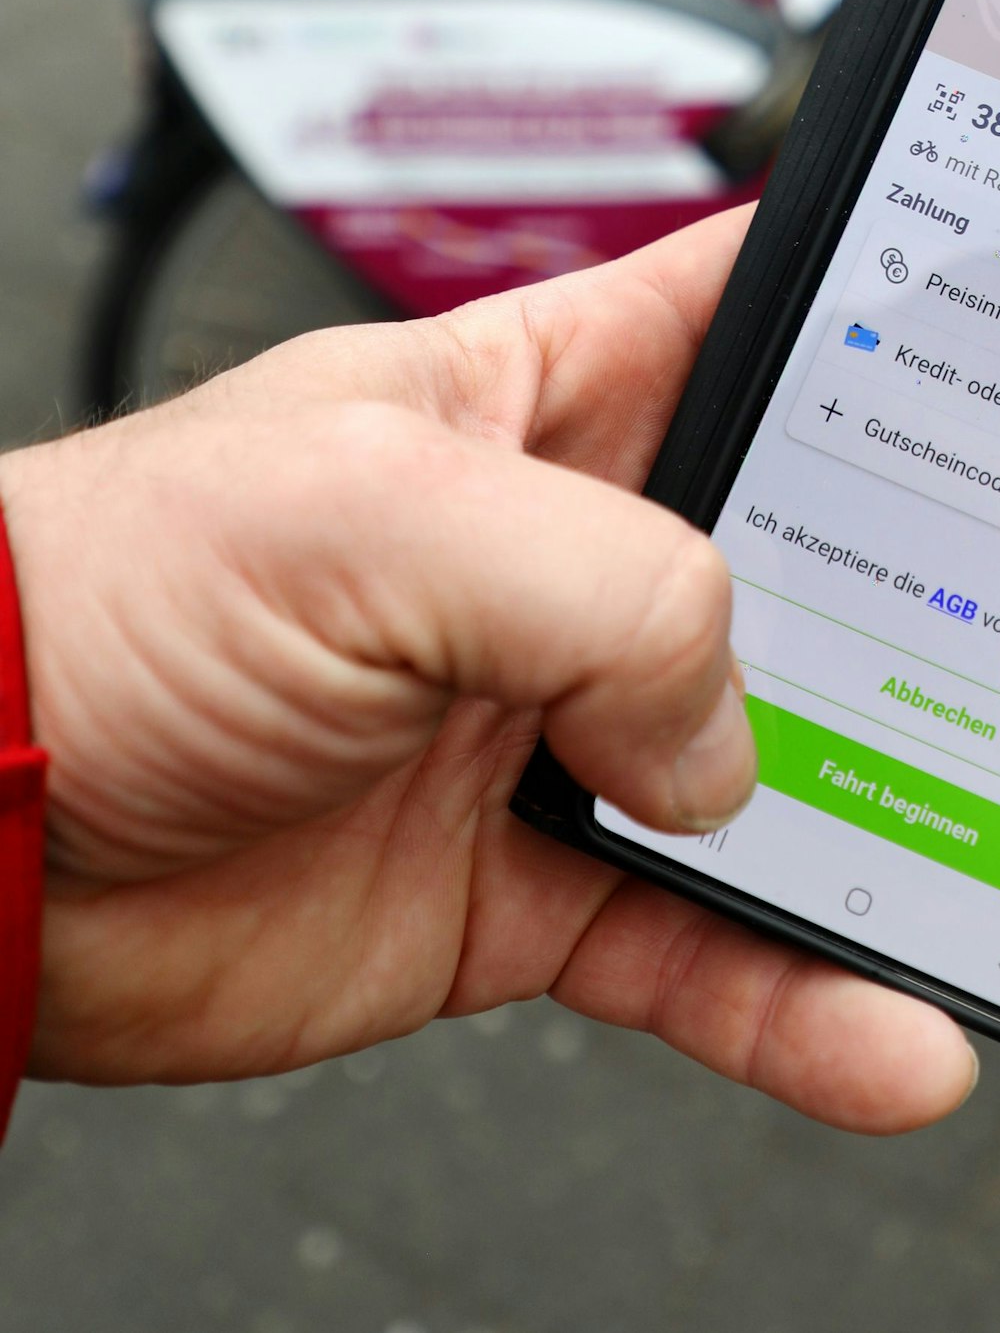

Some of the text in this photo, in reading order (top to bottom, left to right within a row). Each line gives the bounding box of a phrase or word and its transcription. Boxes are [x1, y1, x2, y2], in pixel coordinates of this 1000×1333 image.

[944, 154, 980, 182] mit
[886, 183, 971, 236] Zahlung
[894, 345, 962, 386] Kredit-
[745, 505, 778, 535] Ich
[781, 524, 889, 583] akzeptiere
[892, 572, 927, 599] die
[926, 587, 979, 624] AGB
[879, 676, 998, 742] Abbrechen
[817, 759, 980, 847] Fahrt beginnen
